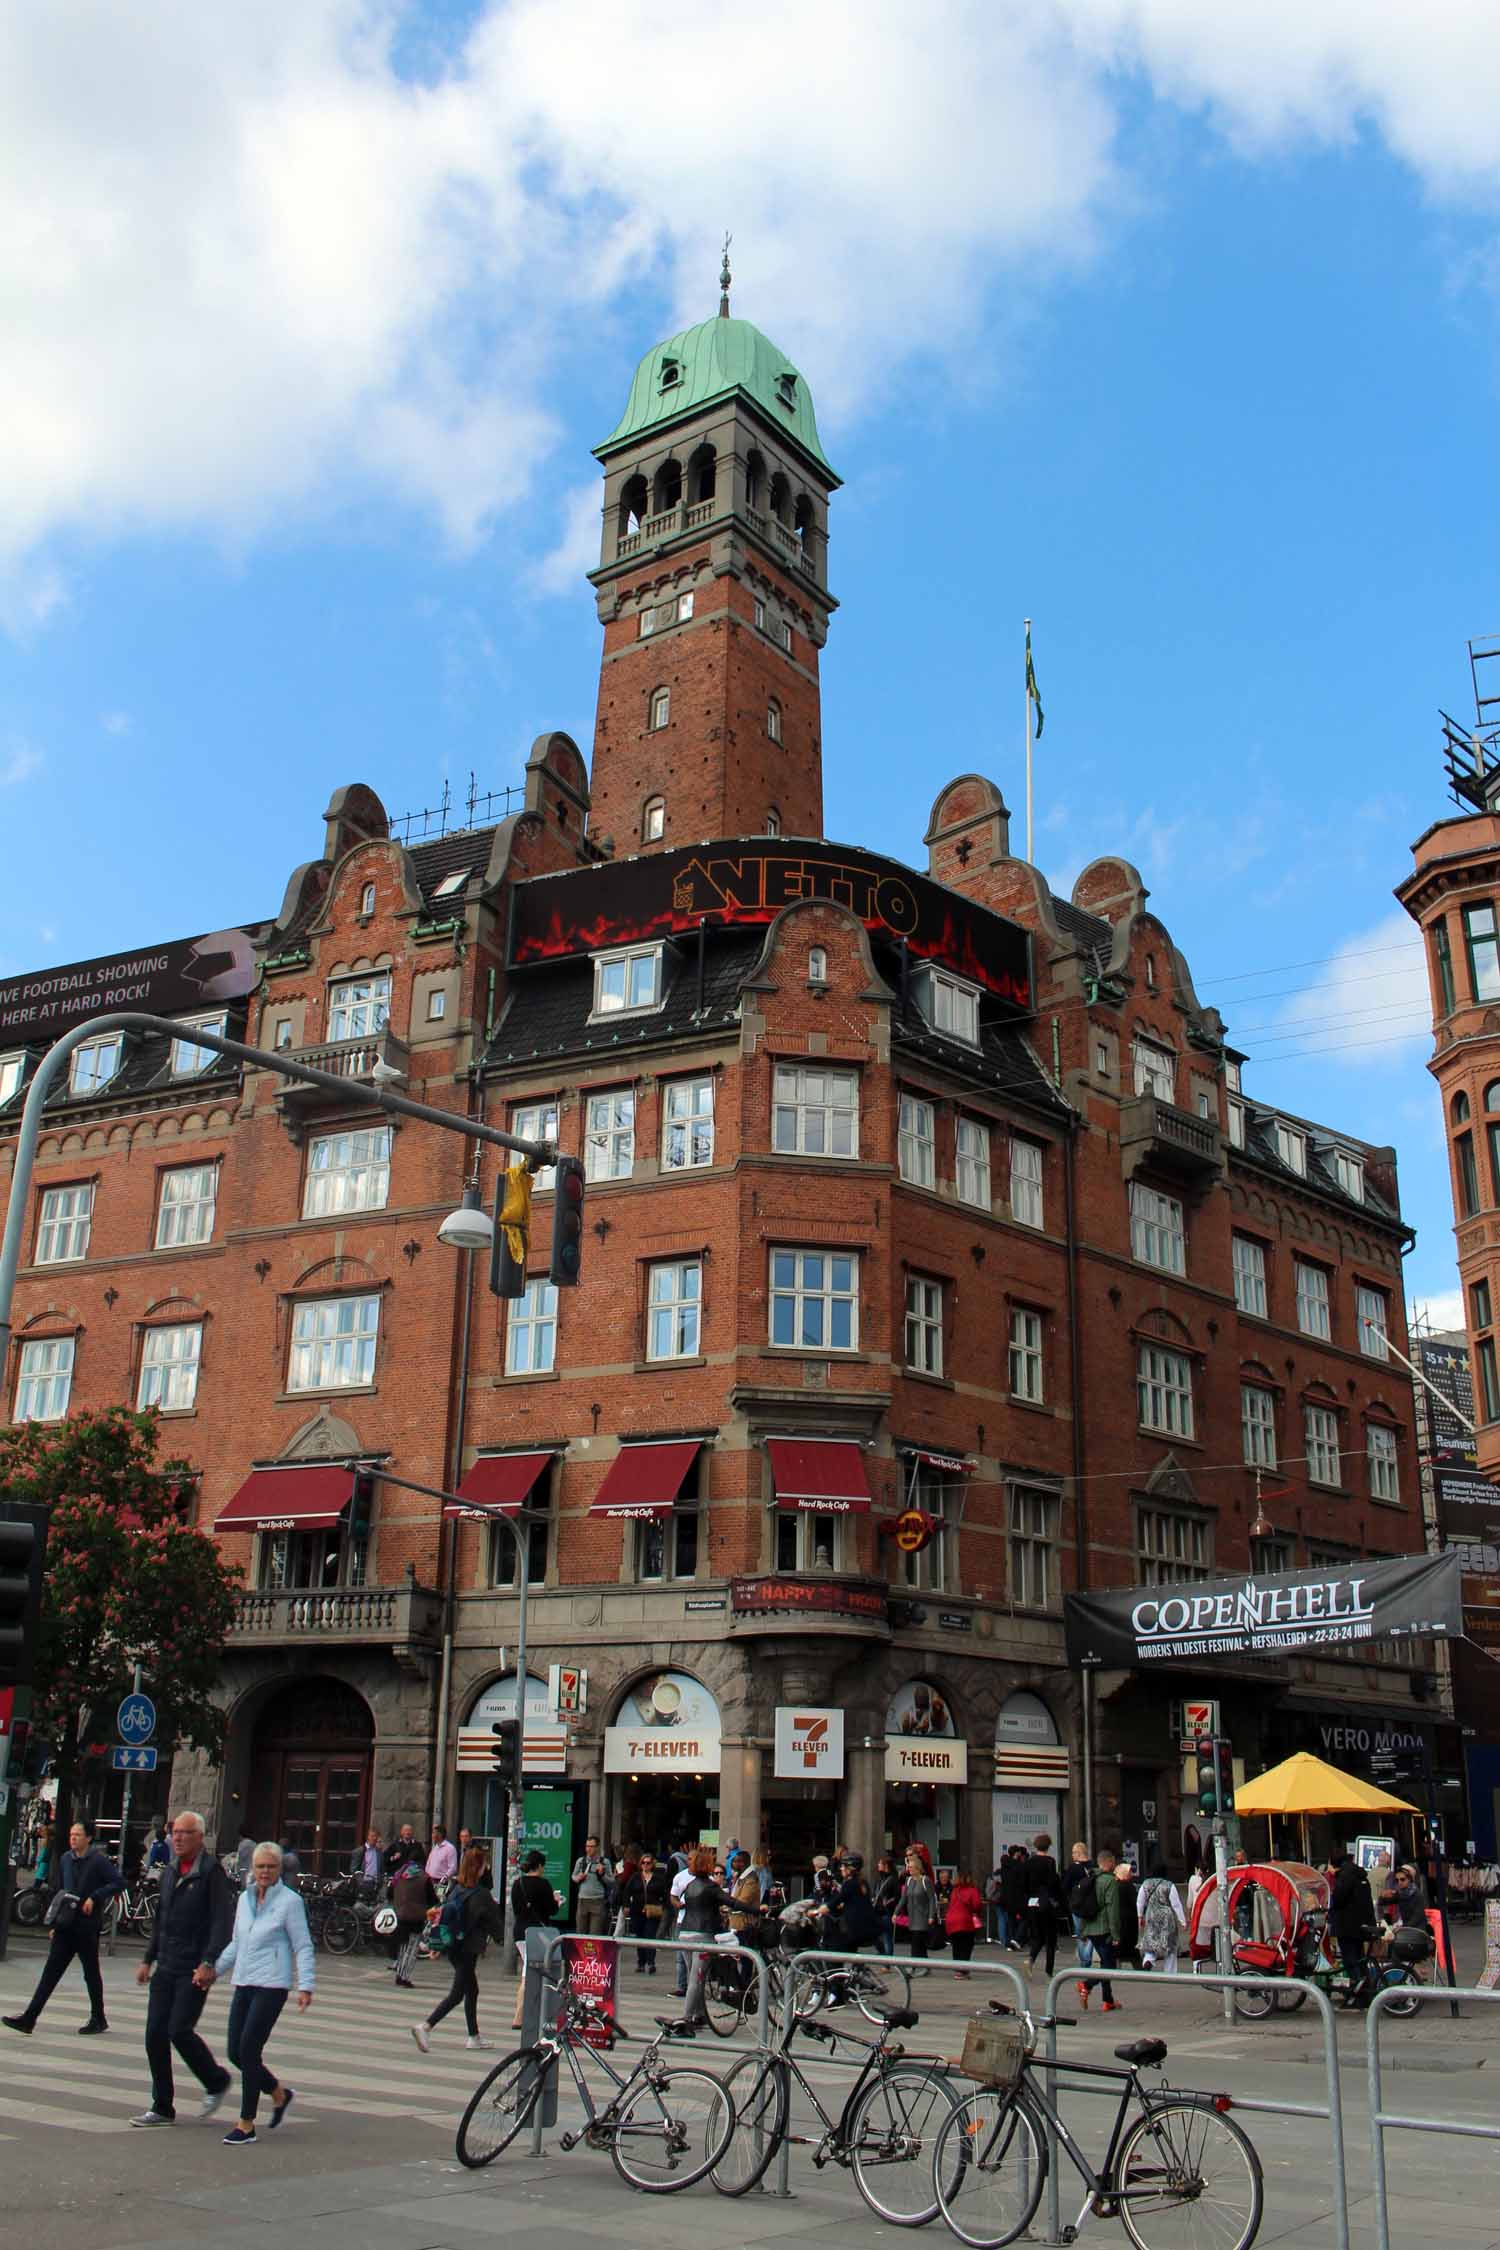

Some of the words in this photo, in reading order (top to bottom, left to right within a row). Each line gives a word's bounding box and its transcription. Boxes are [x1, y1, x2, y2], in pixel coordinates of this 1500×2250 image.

[0, 988, 20, 1004] IVE
[23, 972, 93, 1000] FOOTBALL
[96, 955, 169, 984] SHOWING
[1, 1006, 38, 1026] HERE
[39, 1002, 59, 1019] AT
[61, 993, 101, 1015] HARD
[105, 981, 151, 1004] ROCK!
[607, 1509, 624, 1517] Hard
[623, 1509, 639, 1518] Rock
[639, 1508, 654, 1518] Cafe
[798, 1499, 816, 1508] Hard
[816, 1500, 834, 1510] Rock
[834, 1501, 850, 1511] Cafe
[257, 1521, 270, 1529] Hard
[270, 1520, 283, 1530] Rock
[283, 1520, 296, 1529] Cafe
[761, 1583, 817, 1601] HAPPY
[1132, 1580, 1375, 1634] COPENHELL
[1138, 1642, 1172, 1659] NORDENS
[1172, 1640, 1208, 1657] VILDESTE
[1208, 1637, 1245, 1653] FESTIVAL
[1354, 1623, 1372, 1638] JUNI
[794, 1717, 828, 1768] 7
[1320, 1727, 1370, 1751] VERO
[1374, 1731, 1424, 1749] MODA
[377, 1914, 395, 1928] JD
[569, 1959, 612, 1977] YEARLY
